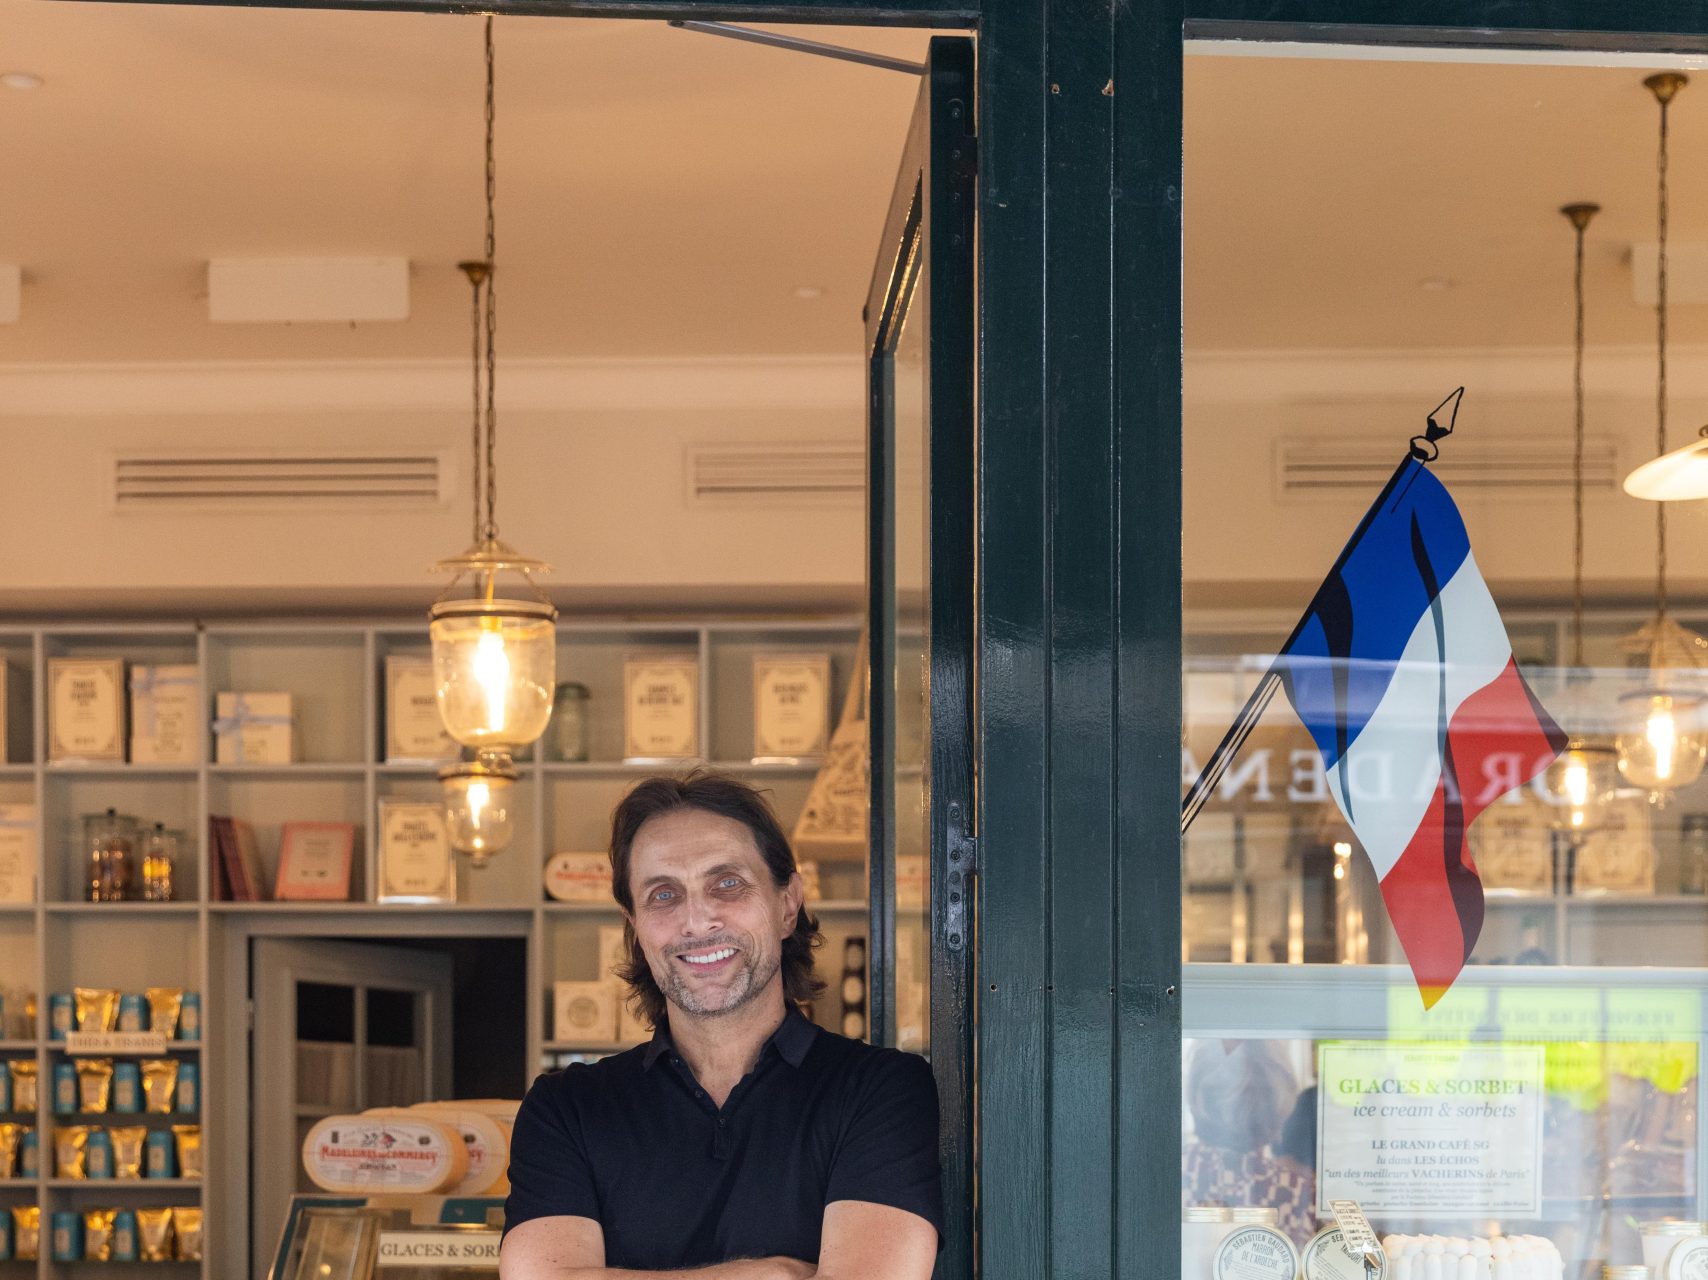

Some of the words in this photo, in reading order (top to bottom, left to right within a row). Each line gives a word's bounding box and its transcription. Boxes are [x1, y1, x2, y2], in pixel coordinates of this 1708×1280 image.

[1339, 1078, 1420, 1094] GLACES
[1424, 1079, 1440, 1094] &
[1445, 1079, 1528, 1094] SORBET
[1353, 1102, 1376, 1117] ice
[1380, 1104, 1433, 1117] cream
[1438, 1102, 1451, 1117] &
[1456, 1102, 1516, 1117] sorbets
[1372, 1140, 1387, 1150] LE
[1390, 1140, 1436, 1150] GRAND
[1438, 1137, 1470, 1150] CAFÉ
[1474, 1140, 1490, 1150] SG
[1414, 1155, 1436, 1165] LES
[1411, 1168, 1484, 1178] VACHERINS
[381, 1243, 444, 1257] GLACES
[447, 1243, 458, 1257] &
[463, 1243, 500, 1257] SOR
